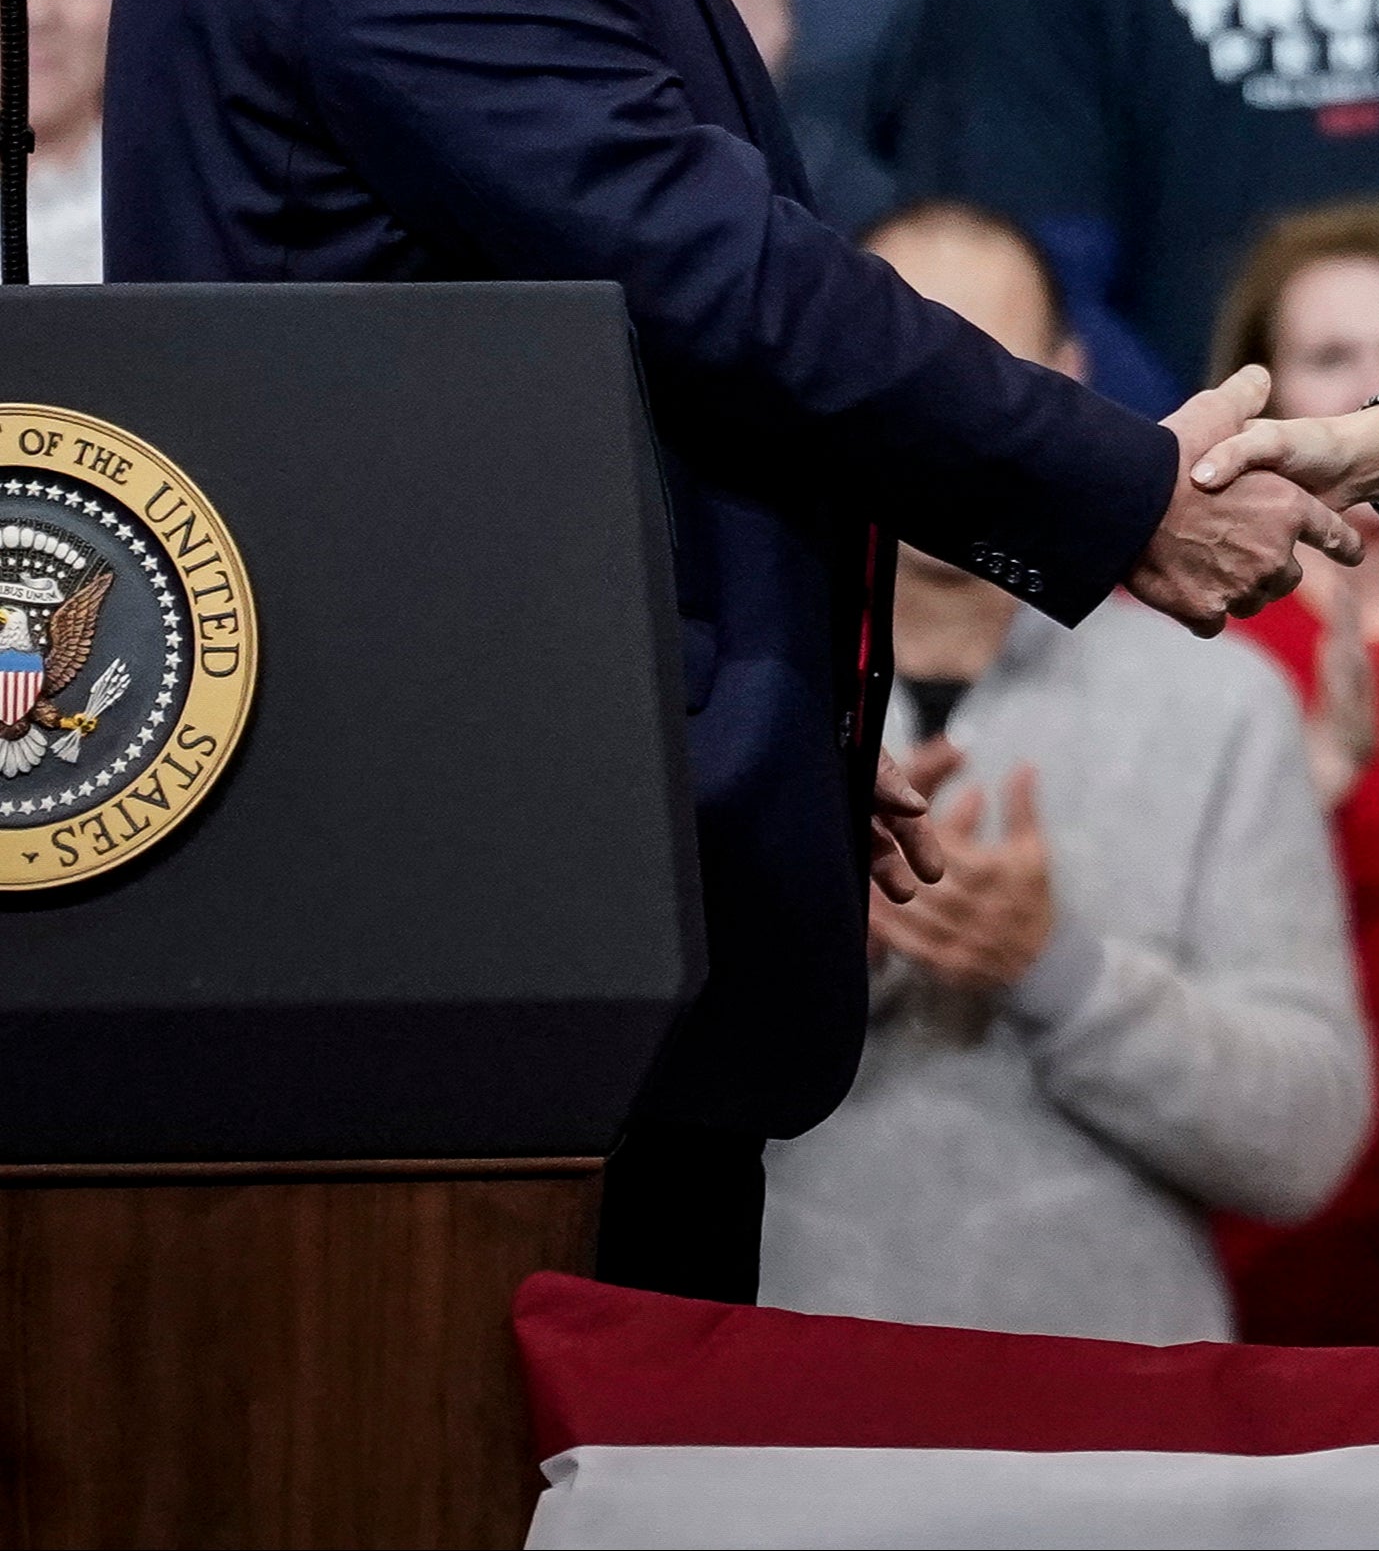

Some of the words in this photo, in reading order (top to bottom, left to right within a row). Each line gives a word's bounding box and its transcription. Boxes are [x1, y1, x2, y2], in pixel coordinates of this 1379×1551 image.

[18, 428, 64, 457] OF
[73, 438, 134, 486] THE
[143, 480, 241, 679] UNITED
[50, 723, 218, 868] STATES
